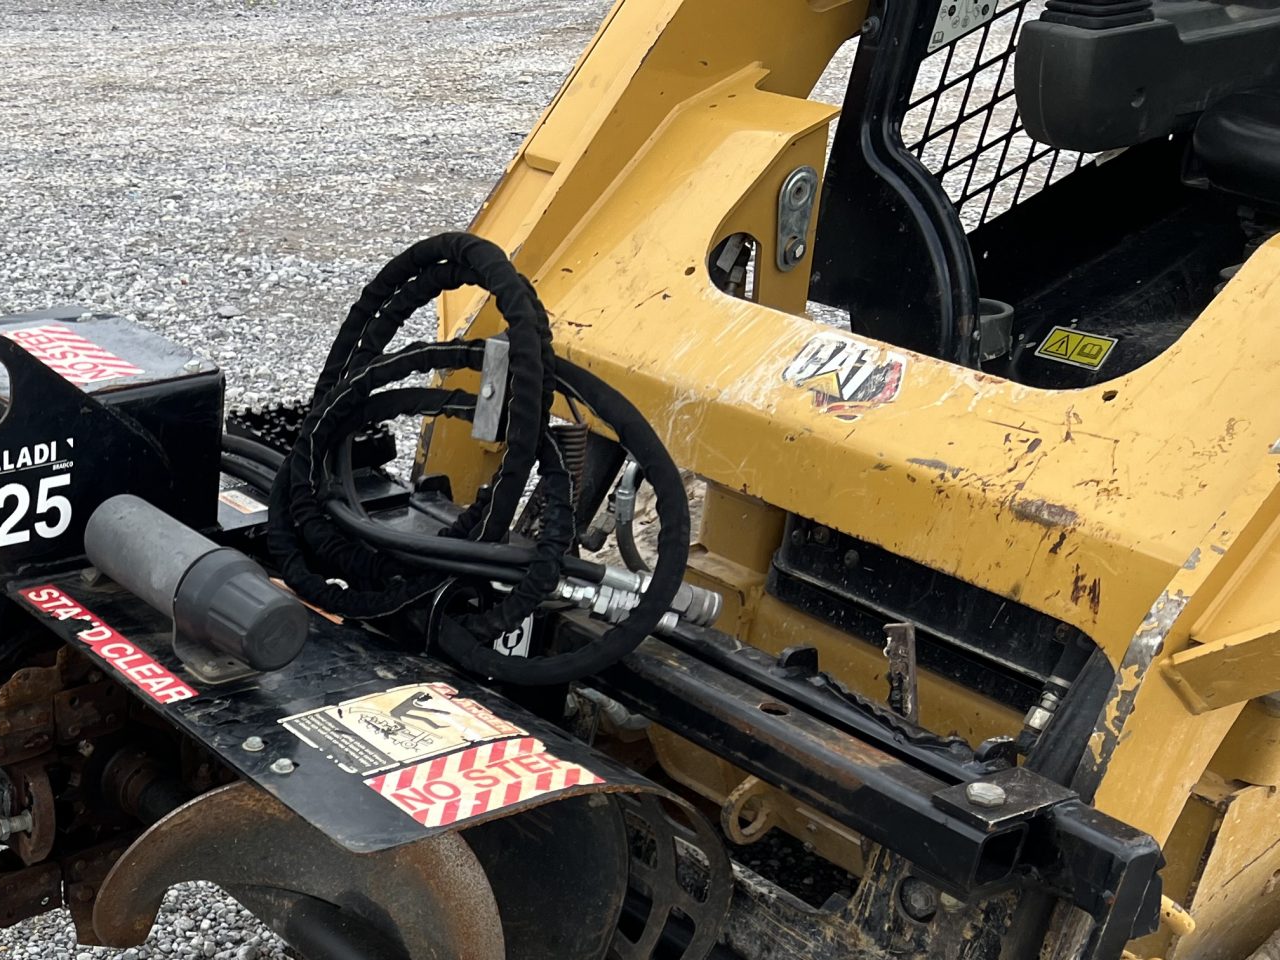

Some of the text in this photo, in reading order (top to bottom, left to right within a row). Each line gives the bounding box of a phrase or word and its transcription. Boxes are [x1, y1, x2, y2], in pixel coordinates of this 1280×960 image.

[13, 330, 117, 380] NO STEP
[100, 643, 194, 705] CLEAR
[390, 780, 461, 811] NO
